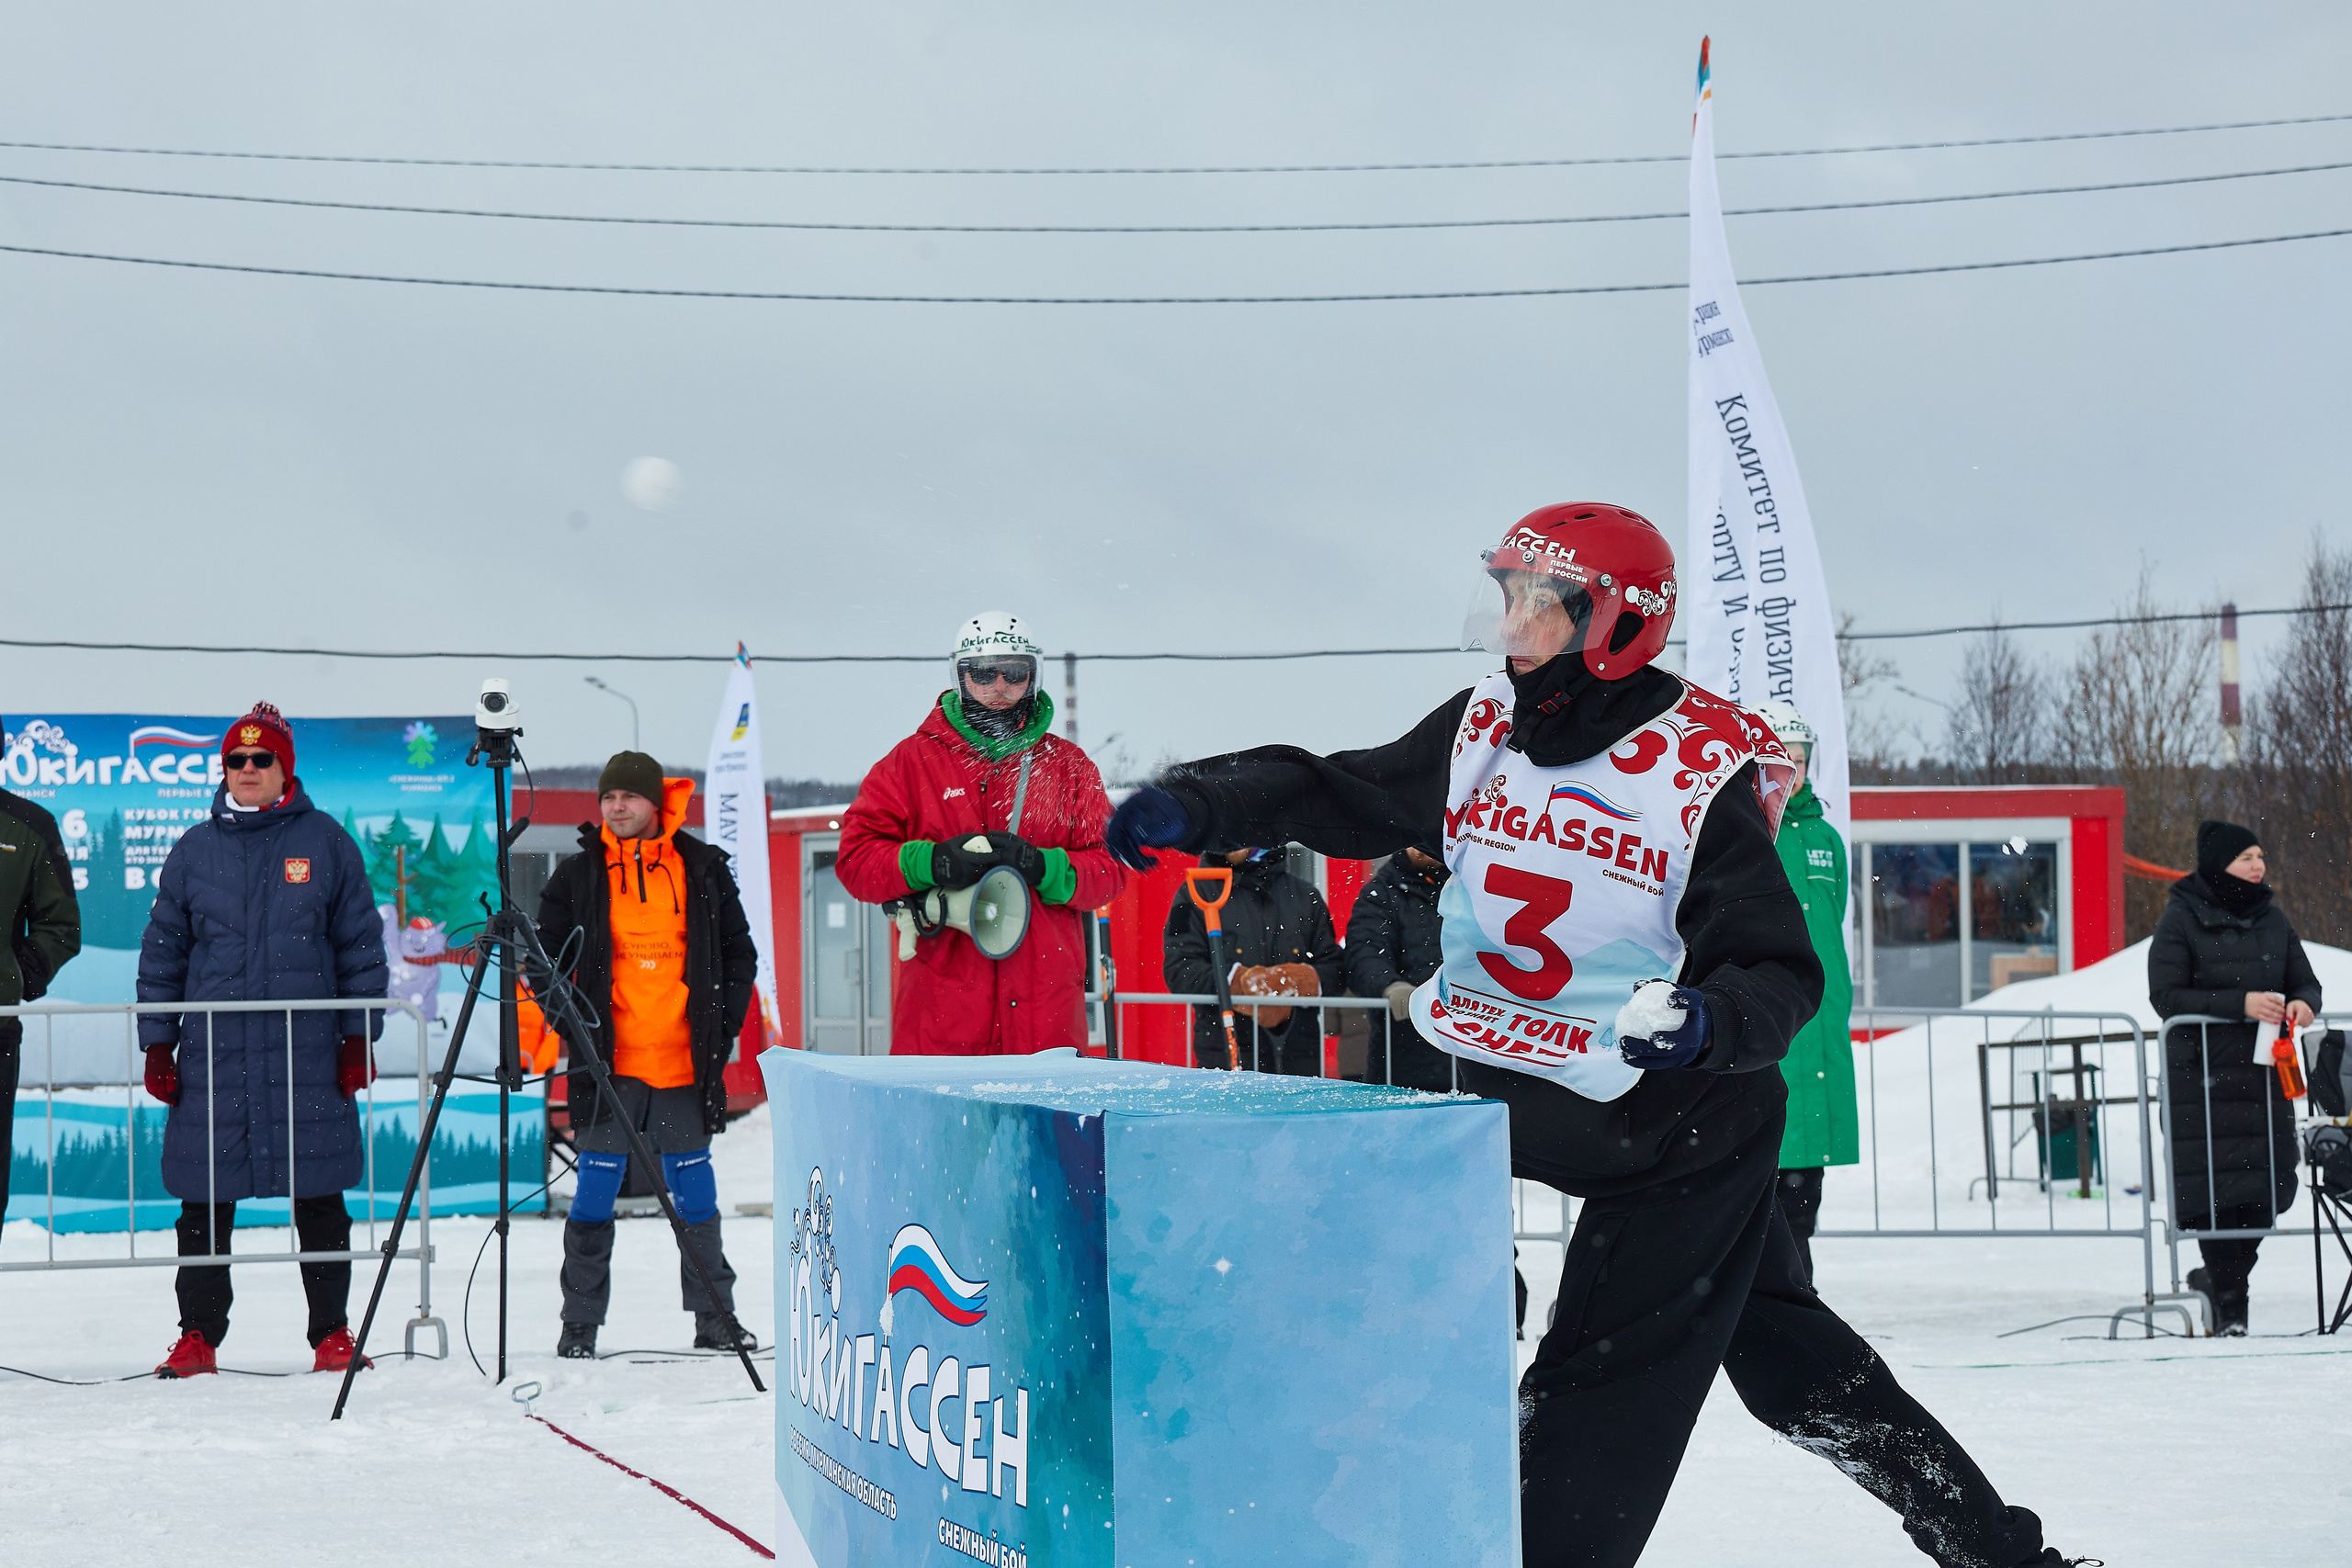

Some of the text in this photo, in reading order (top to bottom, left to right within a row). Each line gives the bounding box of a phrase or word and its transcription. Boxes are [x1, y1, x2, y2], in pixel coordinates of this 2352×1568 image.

[1714, 392, 1796, 702] Комитет по физич
[1550, 559, 1584, 573] ПЕРВЫЕ
[1555, 570, 1589, 583] РОССИИ
[158, 788, 202, 798] ПЕРВЫЕ
[124, 807, 180, 821] КУБОК
[124, 824, 186, 840] МУРМ
[1484, 839, 1517, 853] REGION
[1806, 849, 1825, 860] LET
[1602, 869, 1664, 897] СНЕЖНЫЙ БОЙ
[1476, 863, 1574, 1001] 3
[1451, 995, 1480, 1010] ДЛЯ
[1507, 1013, 1593, 1054] ТОЛК
[790, 1255, 1029, 1509] ЮКИГАССЕН
[810, 1442, 856, 1498] МУРМАНСКАЯ
[857, 1475, 898, 1521] ОБЛАСТЬ
[938, 1517, 1027, 1568] СНЕЖНЫЙ БОЙ
